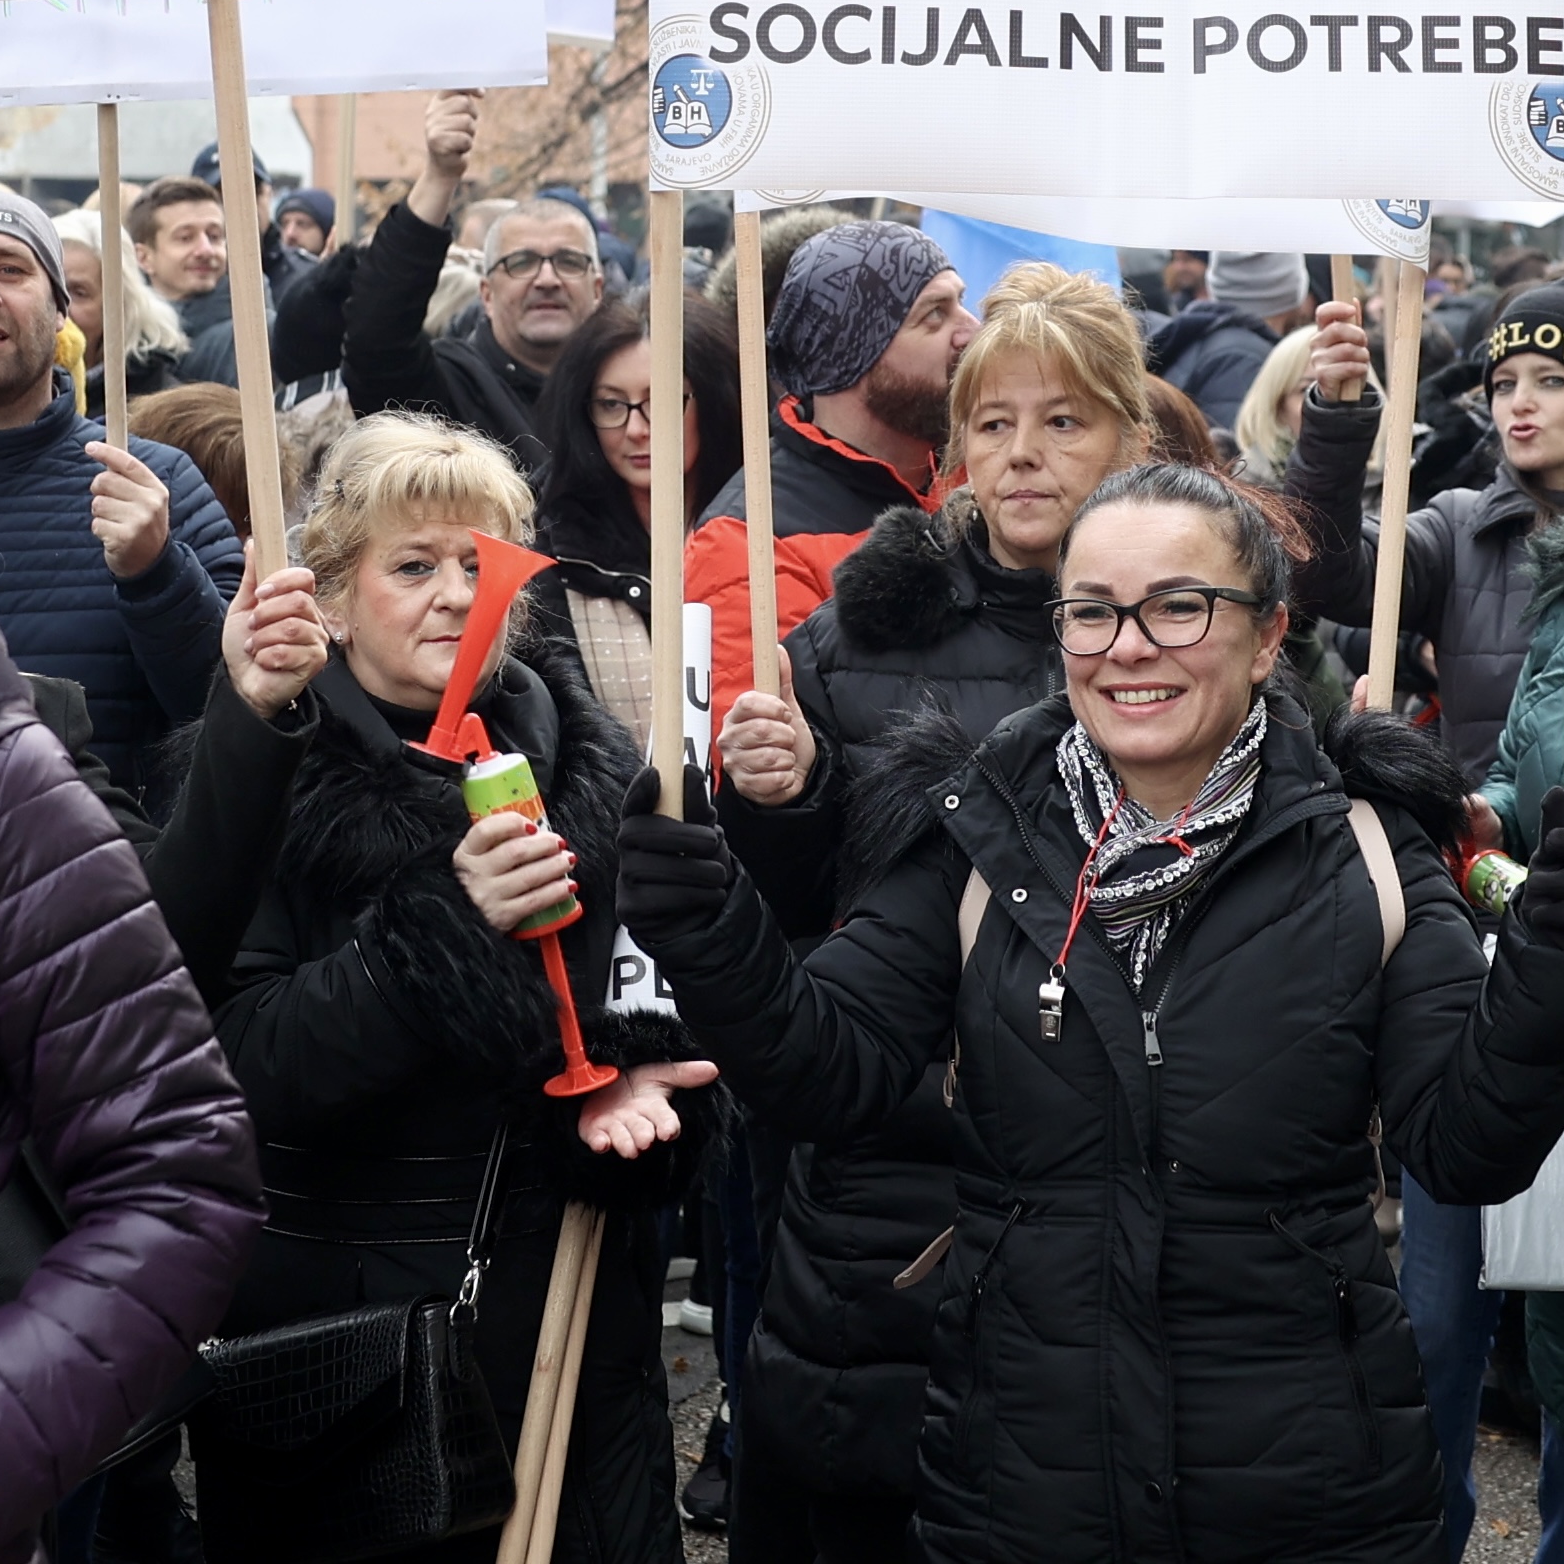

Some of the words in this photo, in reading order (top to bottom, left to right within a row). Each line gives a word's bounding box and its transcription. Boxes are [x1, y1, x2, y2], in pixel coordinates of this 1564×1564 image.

[708, 2, 1164, 73] SOCIJALNE
[1193, 14, 1564, 76] POTREBE
[665, 152, 712, 166] SARAJEVO
